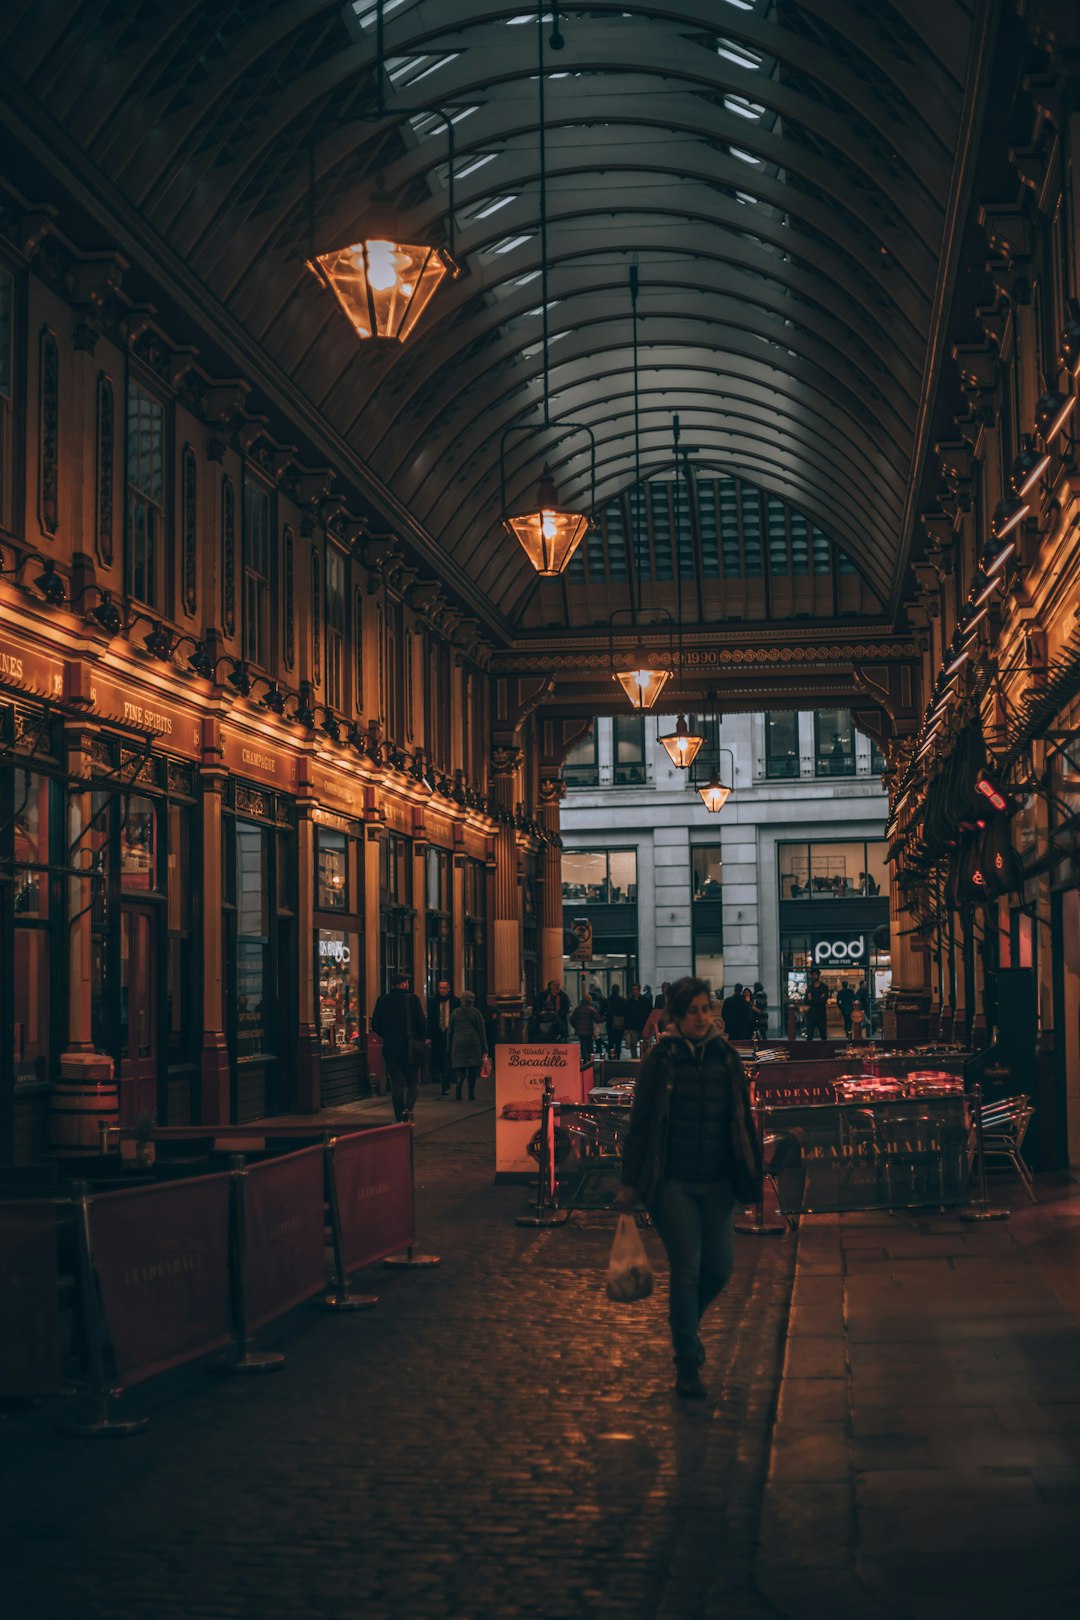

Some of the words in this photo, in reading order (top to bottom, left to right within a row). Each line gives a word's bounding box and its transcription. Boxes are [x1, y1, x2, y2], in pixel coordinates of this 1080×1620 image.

[687, 651, 716, 664] 1990
[124, 701, 143, 723] FINE
[144, 709, 172, 735] SPIRITS
[242, 748, 276, 773] CHAMPAGNE
[815, 935, 864, 964] pod
[509, 1055, 568, 1067] Bocadillo
